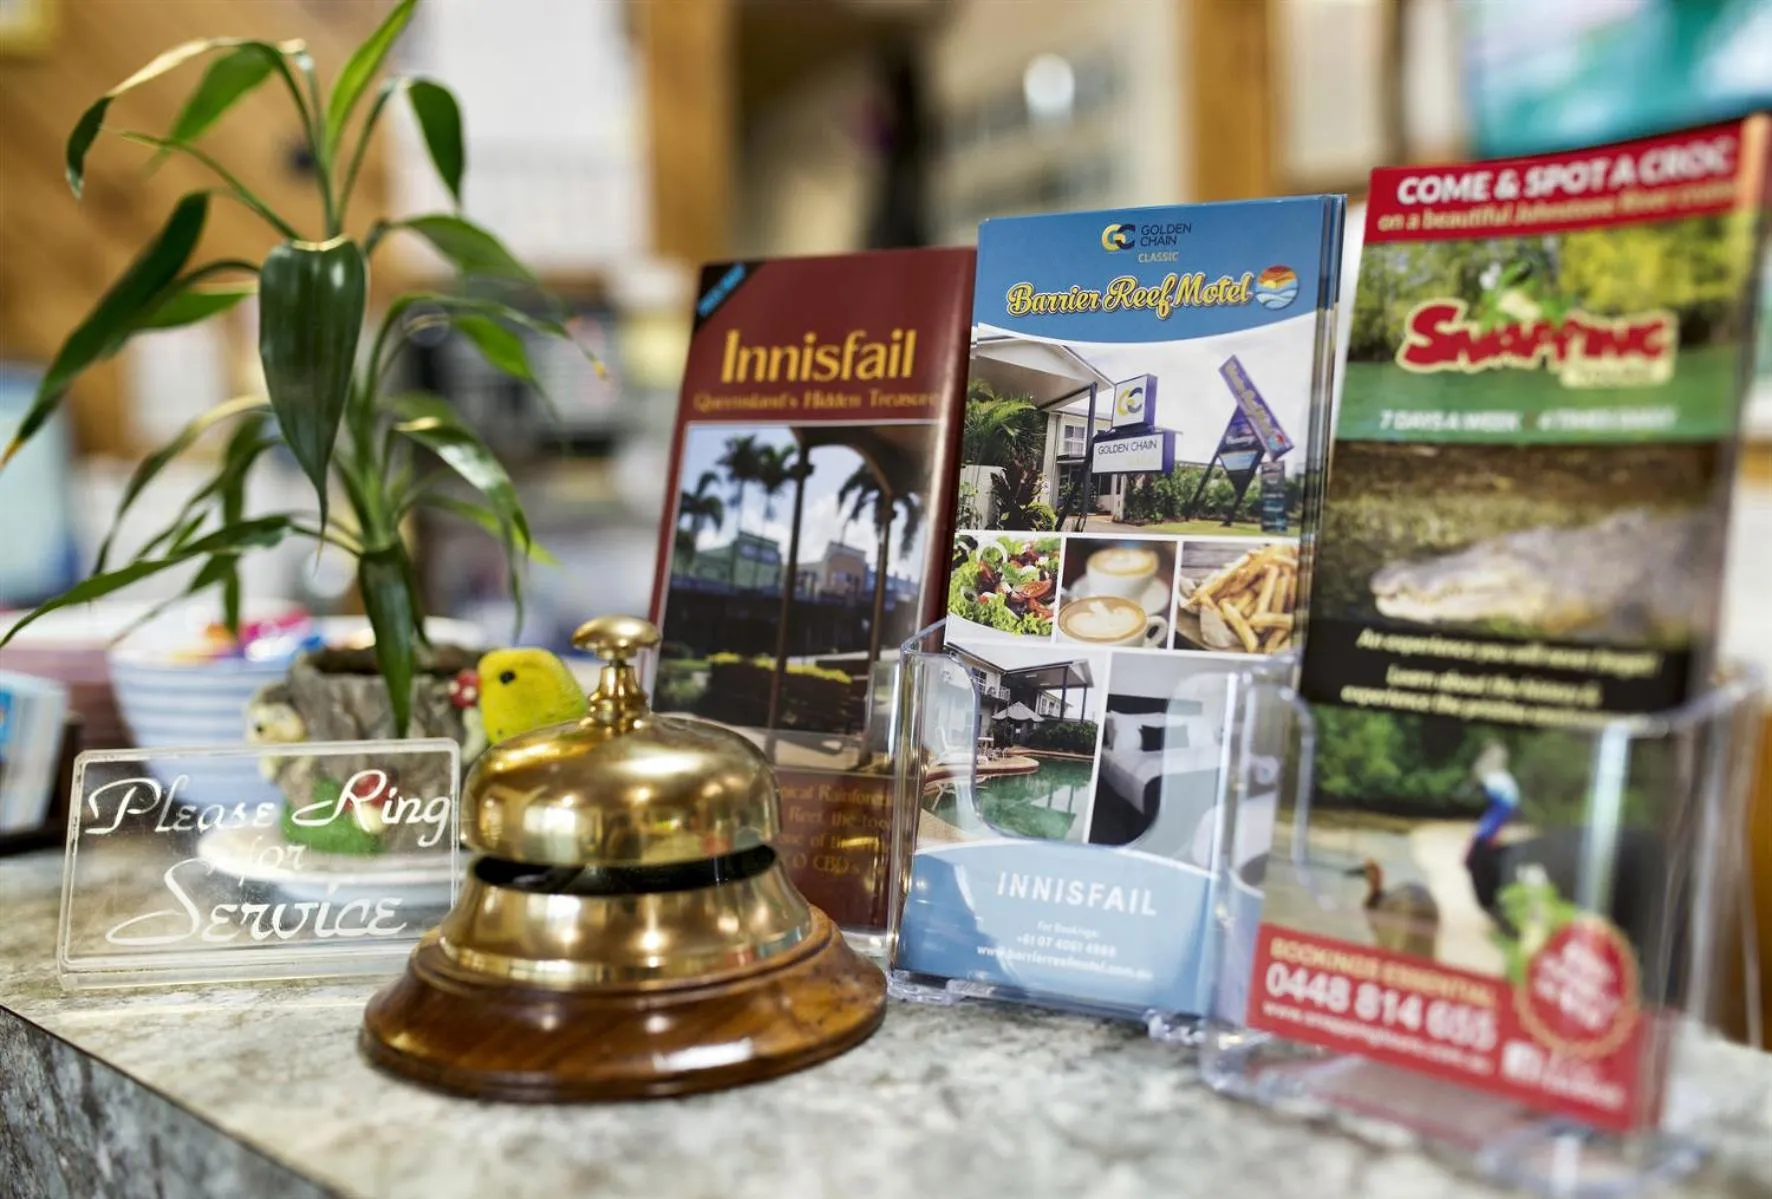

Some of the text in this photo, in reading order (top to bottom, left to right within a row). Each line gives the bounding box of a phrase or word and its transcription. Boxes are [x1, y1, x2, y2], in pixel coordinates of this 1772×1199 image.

[1397, 137, 1736, 205] COME & SPOT A CROC
[1140, 222, 1192, 235] GOLDEN
[1378, 211, 1404, 232] on
[1406, 211, 1419, 230] a
[1422, 201, 1508, 230] beautiful
[1138, 251, 1180, 264] CLASSIC
[1139, 234, 1178, 247] CHAIN
[1006, 270, 1254, 321] Barrier Reef Motel
[721, 328, 917, 383] Innisfail
[803, 388, 862, 410] Hidden
[1098, 440, 1157, 455] GOLDEN CHAIN
[85, 768, 452, 848] Please Ring
[105, 857, 407, 946] Service
[996, 870, 1157, 917] INNISFAIL
[1036, 935, 1053, 948] 07
[1264, 962, 1351, 1013] 0448
[1353, 981, 1423, 1031] 814
